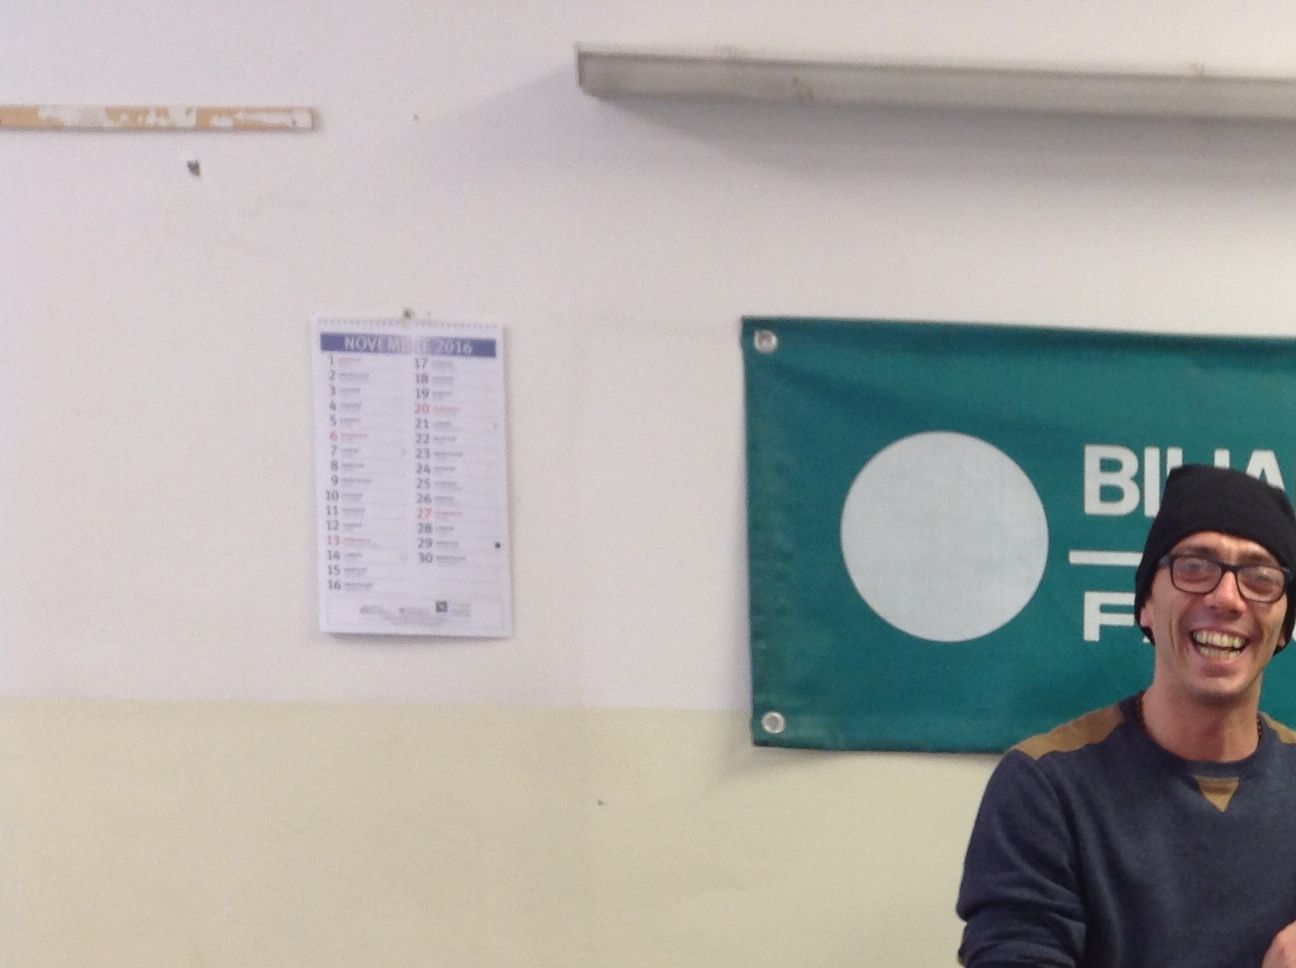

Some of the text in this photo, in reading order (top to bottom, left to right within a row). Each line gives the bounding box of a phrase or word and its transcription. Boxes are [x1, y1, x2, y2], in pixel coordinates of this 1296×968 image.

[414, 358, 428, 369] 17
[415, 373, 429, 383] 18
[415, 388, 429, 399] 19
[414, 403, 430, 414] 20
[415, 419, 429, 429] 21
[415, 434, 430, 444] 22
[415, 449, 430, 459] 23
[416, 464, 431, 474] 24
[416, 479, 431, 489] 25
[326, 490, 339, 500] 10
[416, 494, 432, 504] 26
[326, 505, 338, 515] 11
[417, 509, 432, 519] 27
[326, 520, 339, 530] 12
[417, 524, 433, 534] 28
[327, 535, 340, 545] 13
[417, 538, 433, 549] 29
[327, 550, 340, 560] 14
[418, 553, 433, 564] 30
[328, 565, 340, 575] 15
[328, 580, 341, 590] 16
